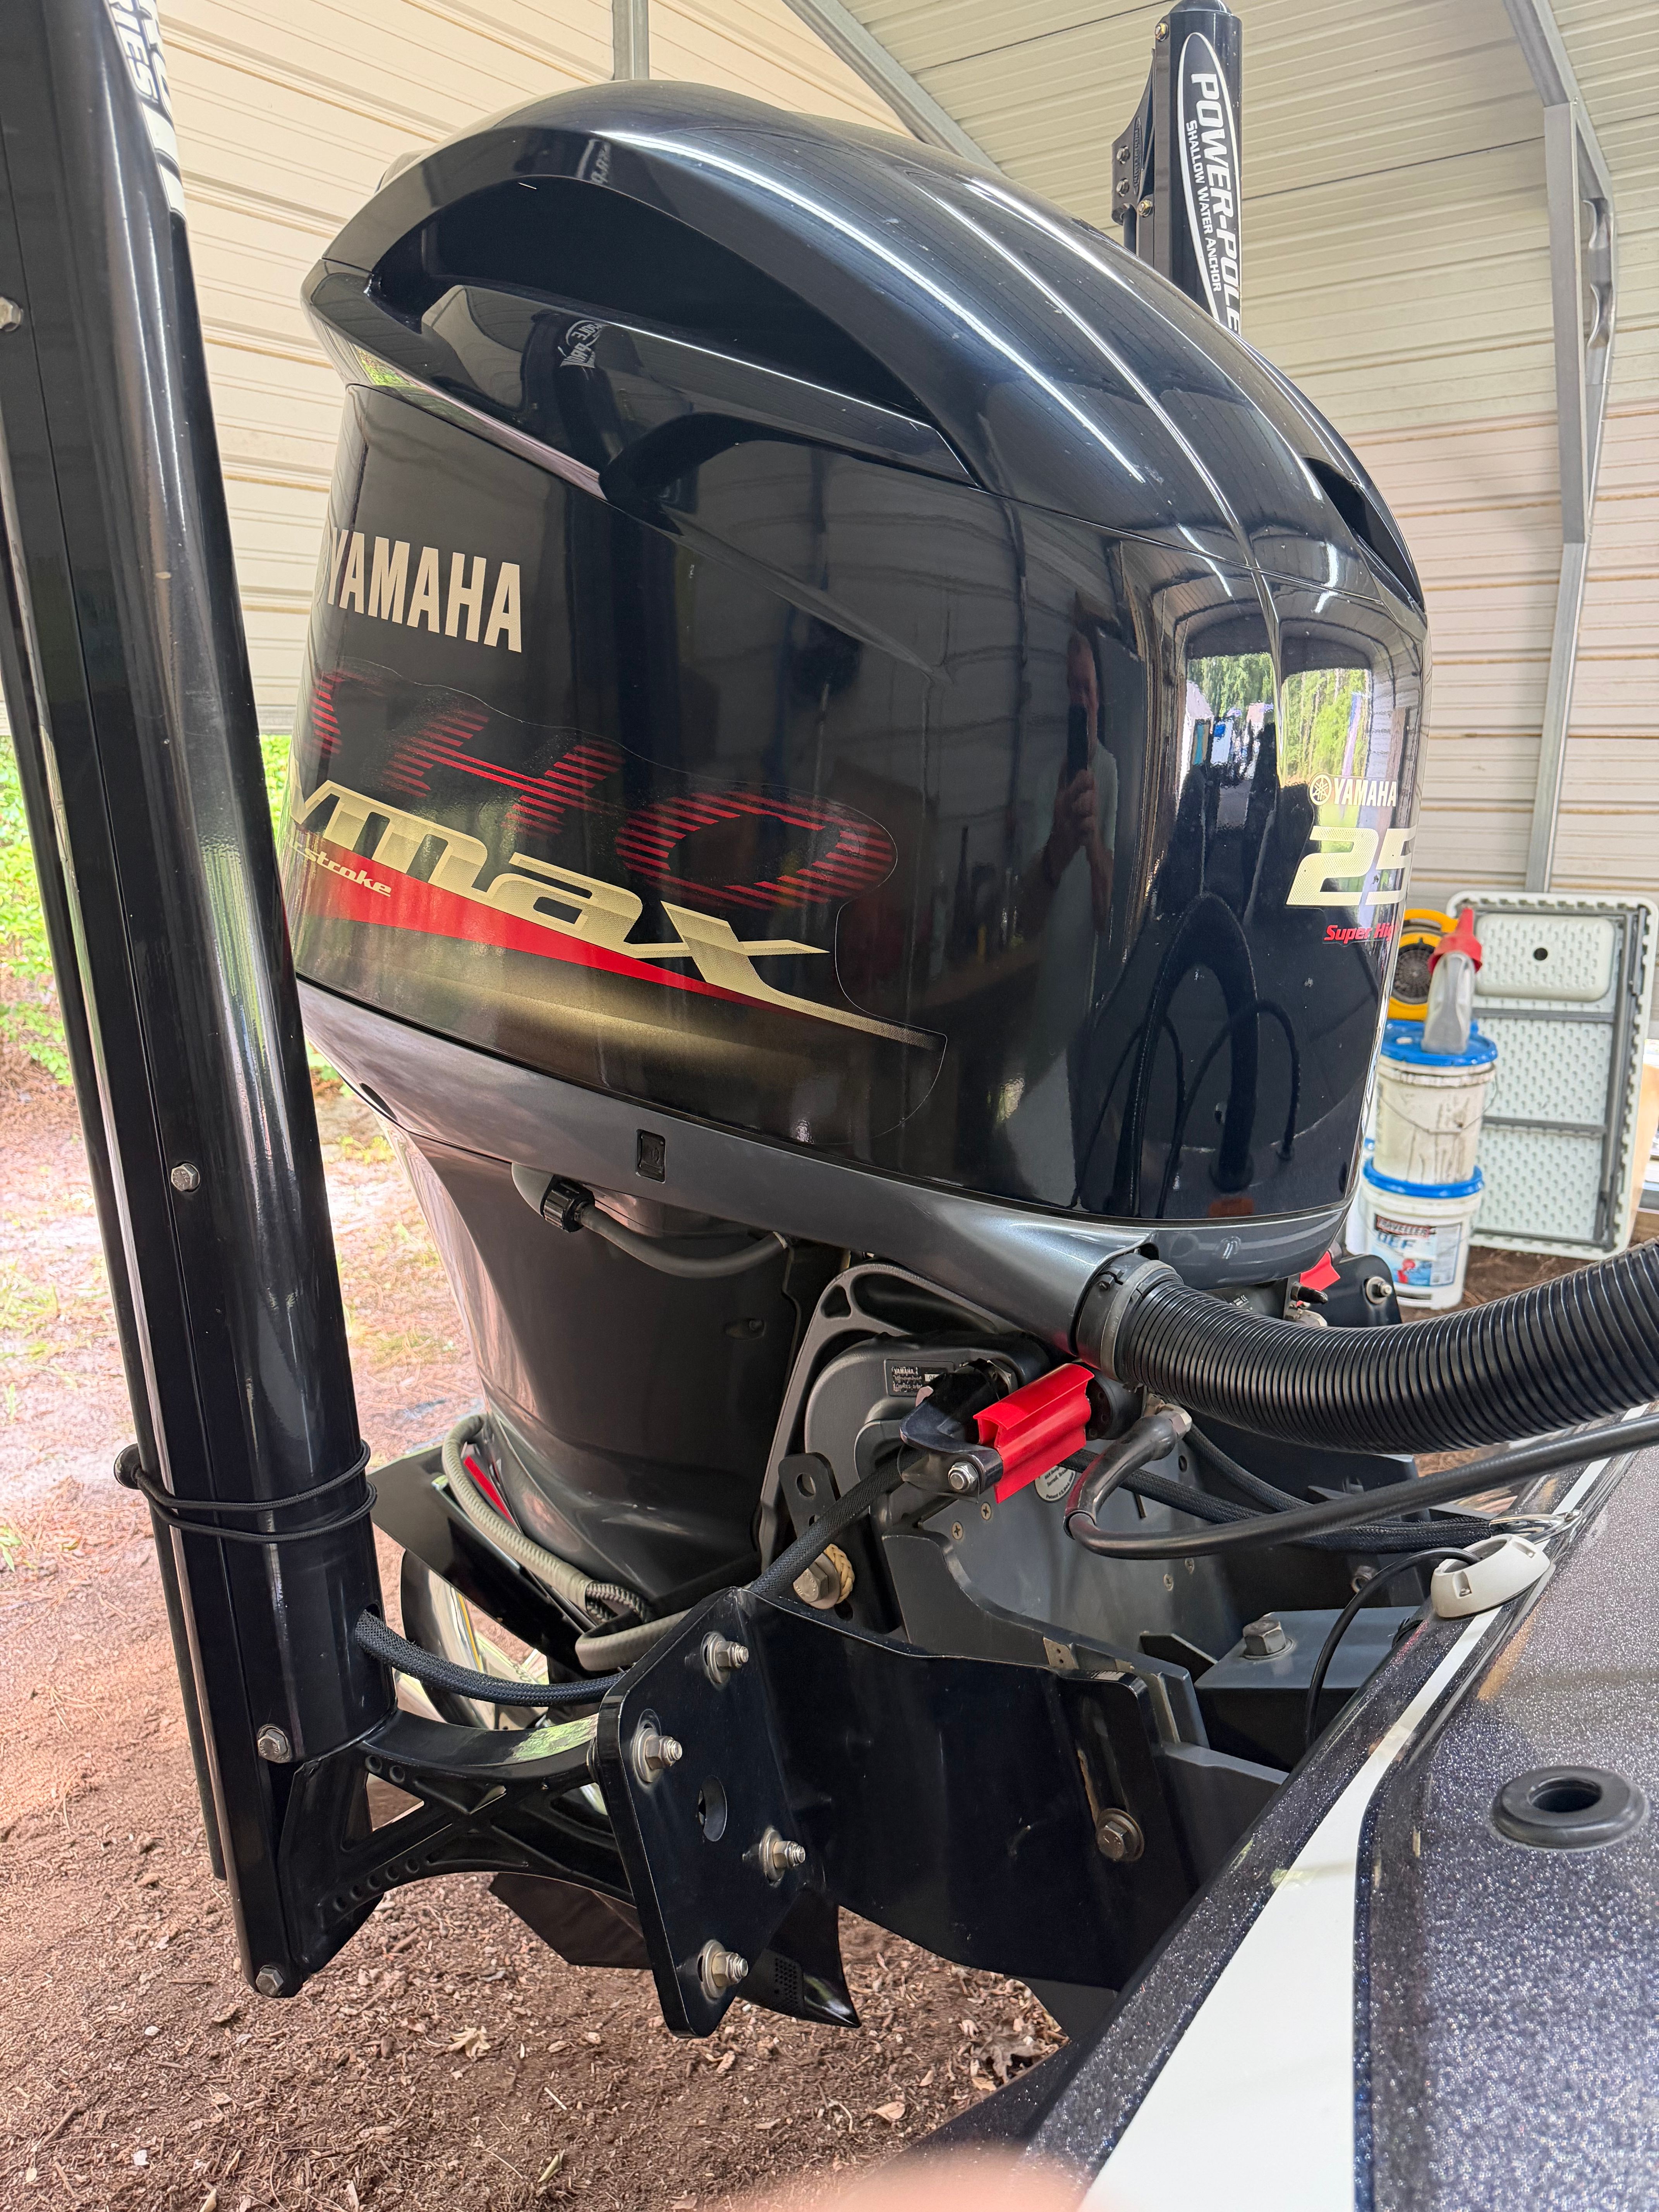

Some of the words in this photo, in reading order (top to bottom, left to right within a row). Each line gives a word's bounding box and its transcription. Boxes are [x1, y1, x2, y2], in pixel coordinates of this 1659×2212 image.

[1185, 120, 1205, 184] SHALLOW
[1197, 187, 1213, 235] WATER
[1205, 237, 1221, 292] ANCHOR
[1191, 73, 1240, 331] POWER-POLE
[328, 527, 522, 653] YAMAHA
[1334, 778, 1397, 807] YAMAHA
[1324, 924, 1372, 944] Super
